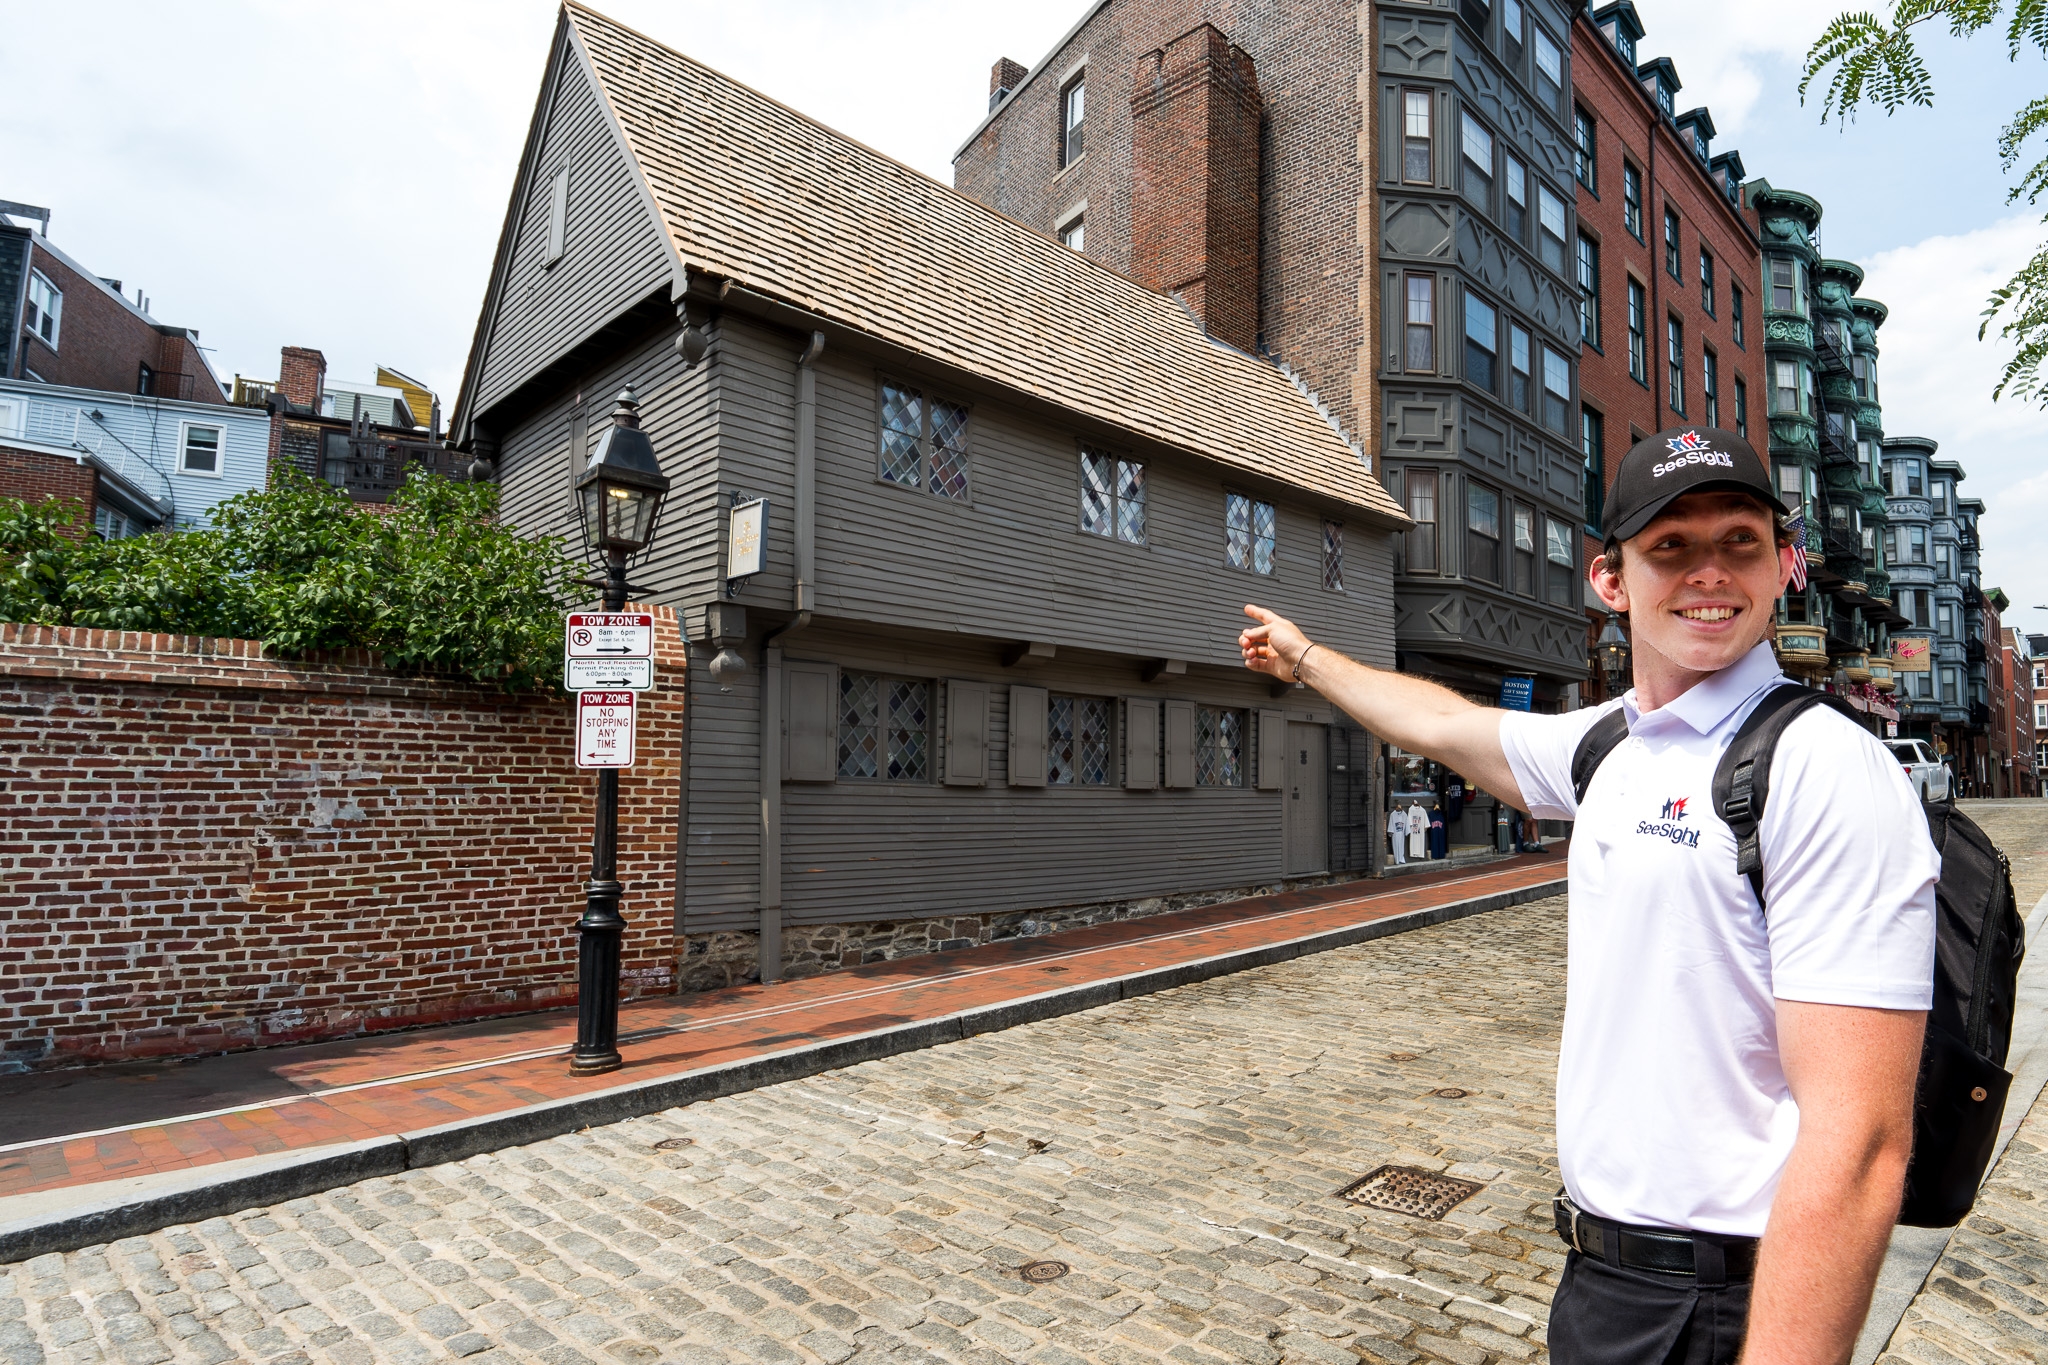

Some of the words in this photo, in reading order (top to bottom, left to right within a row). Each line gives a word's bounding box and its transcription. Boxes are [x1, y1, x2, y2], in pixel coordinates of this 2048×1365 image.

[1652, 450, 1731, 478] SeeSight
[581, 616, 605, 626] TOW
[608, 616, 641, 626] ZONE
[598, 628, 613, 636] 8am
[620, 628, 636, 637] 6pm
[1504, 681, 1530, 689] BOSTON
[583, 694, 603, 704] TOW
[605, 693, 630, 704] ZONE
[599, 708, 615, 718] NO
[586, 718, 629, 728] STOPPING
[597, 729, 617, 738] ANY
[596, 739, 617, 749] TIME
[1636, 820, 1701, 844] SeeSight
